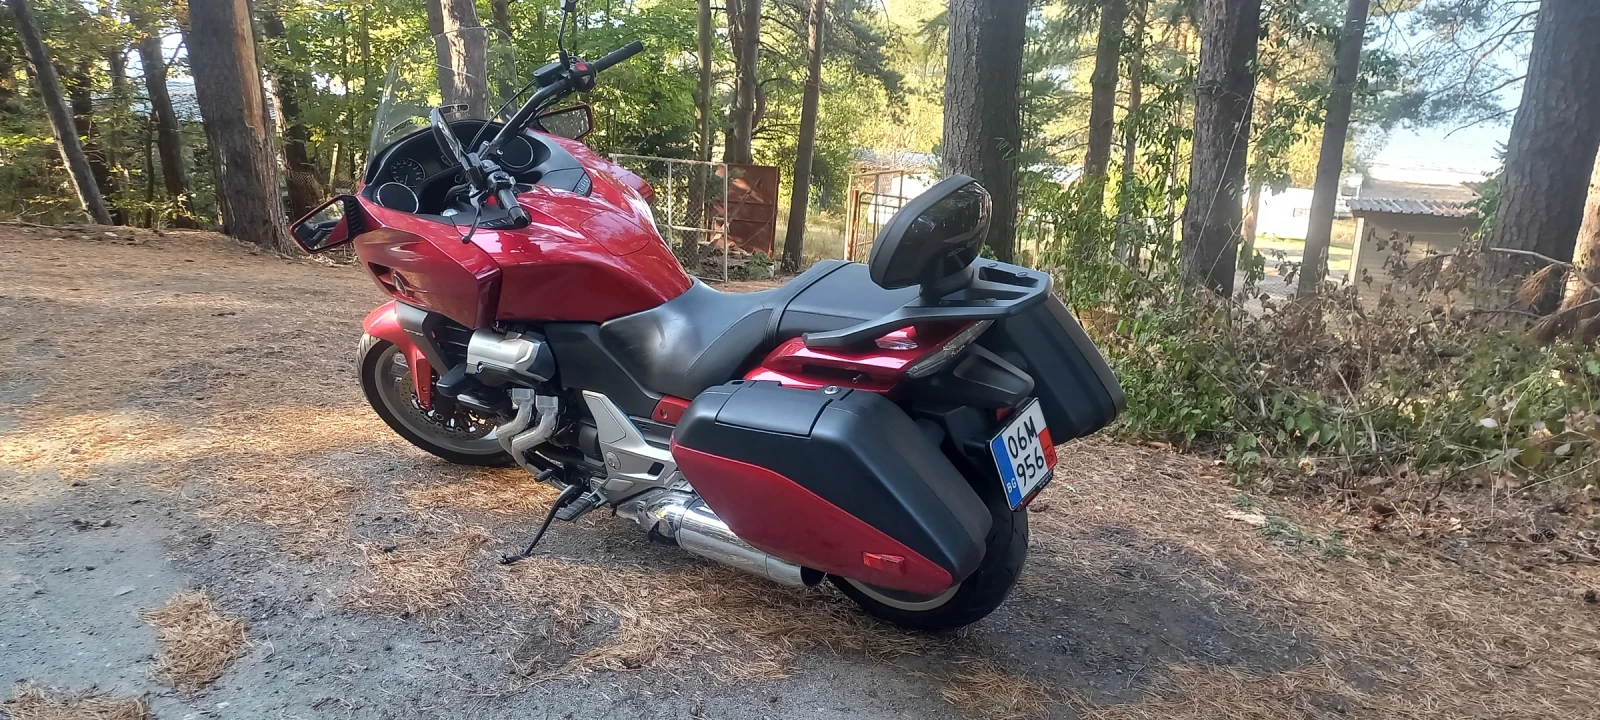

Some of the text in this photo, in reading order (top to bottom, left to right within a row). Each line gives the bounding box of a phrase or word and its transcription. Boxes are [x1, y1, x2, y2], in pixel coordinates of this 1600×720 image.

[1007, 415, 1039, 459] 06M
[1006, 477, 1018, 494] BG
[1016, 445, 1045, 488] 956
